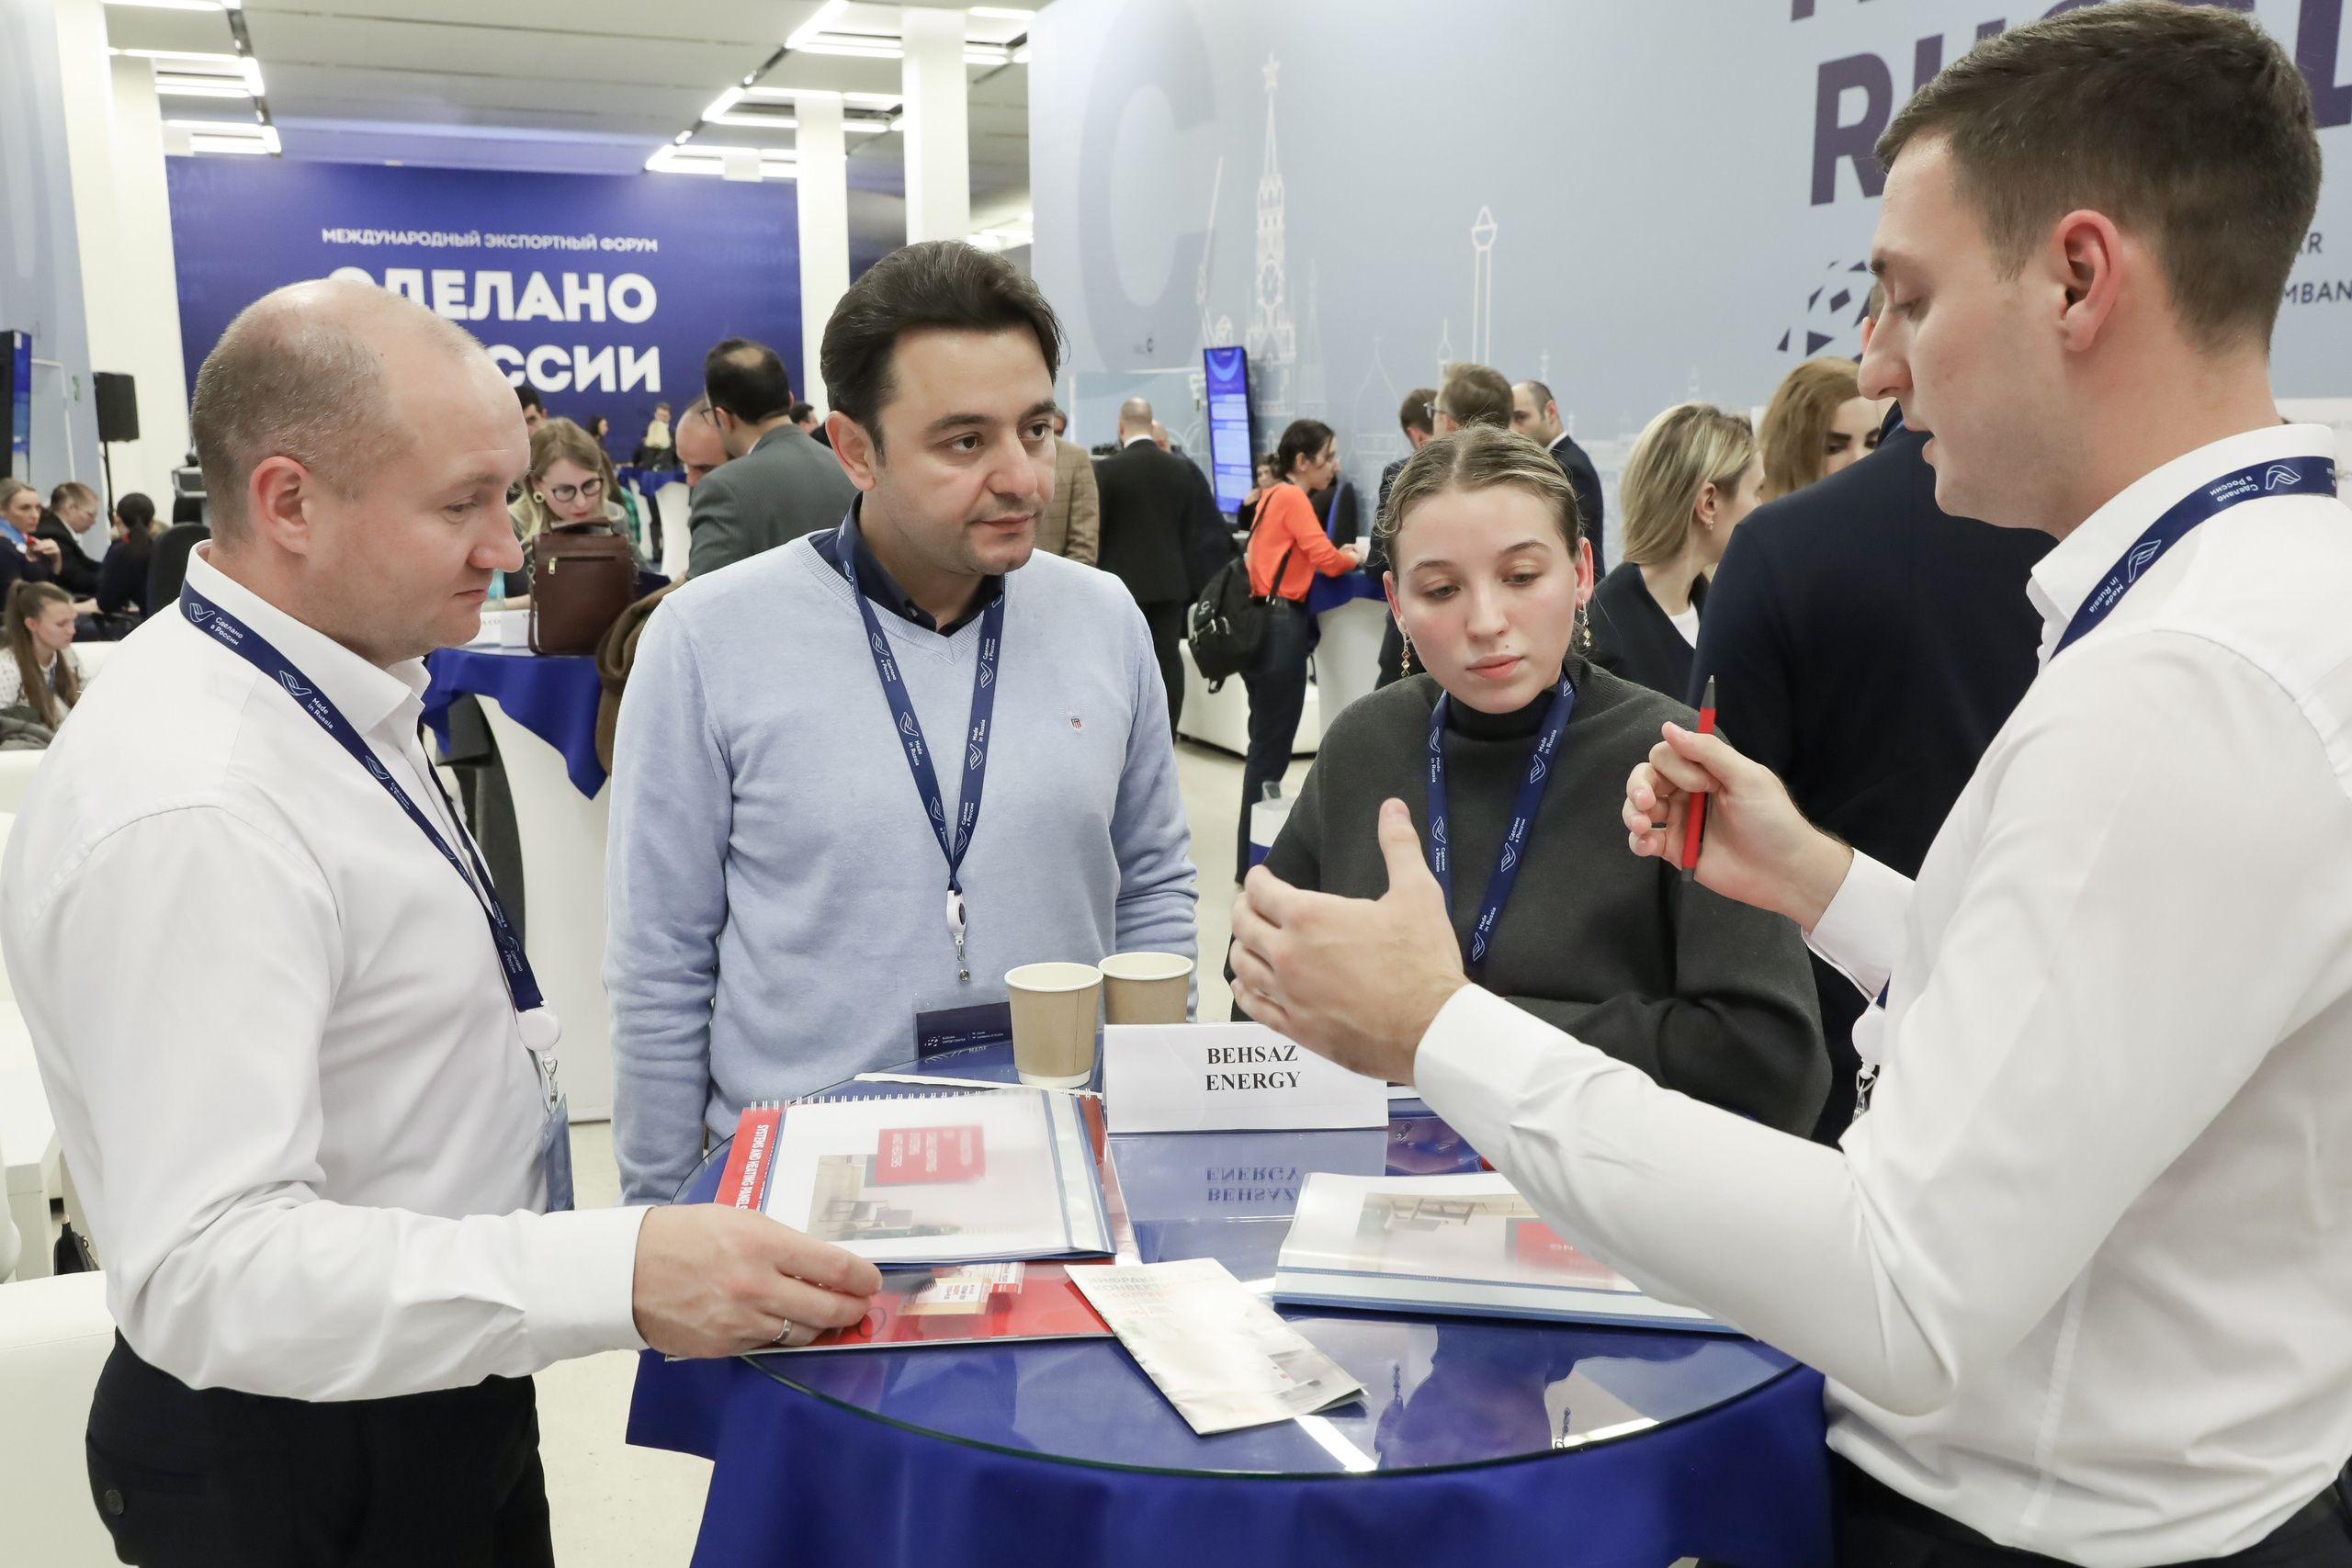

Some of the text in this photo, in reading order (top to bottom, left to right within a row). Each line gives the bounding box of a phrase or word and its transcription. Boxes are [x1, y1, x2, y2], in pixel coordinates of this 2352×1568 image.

[322, 228, 658, 252] МЕЖДУНАРОДНЫЙ ЭКСПОРТНЫЙ ФОРУМ
[328, 266, 657, 324] ДЕЛАНО
[2209, 478, 2246, 496] России
[2216, 484, 2259, 502] Сделано
[2089, 586, 2112, 613] Russia
[2105, 584, 2124, 606] Made
[215, 617, 243, 639] Сделано
[215, 626, 239, 646] России
[312, 697, 329, 714] Made
[307, 703, 333, 729] in Russia
[1538, 737, 1547, 752] Made
[1546, 730, 1557, 748] Russia
[910, 748, 919, 766] Russia
[1508, 817, 1520, 841] Сделано
[1516, 818, 1526, 839] России
[1479, 914, 1487, 930] Made
[1486, 907, 1496, 925] Russia
[1206, 1045, 1298, 1065] BEHSAZ
[1205, 1071, 1301, 1091] ENERGY
[752, 1124, 769, 1148] SYSTEMS
[748, 1149, 763, 1161] AND
[741, 1161, 759, 1186] HEATING
